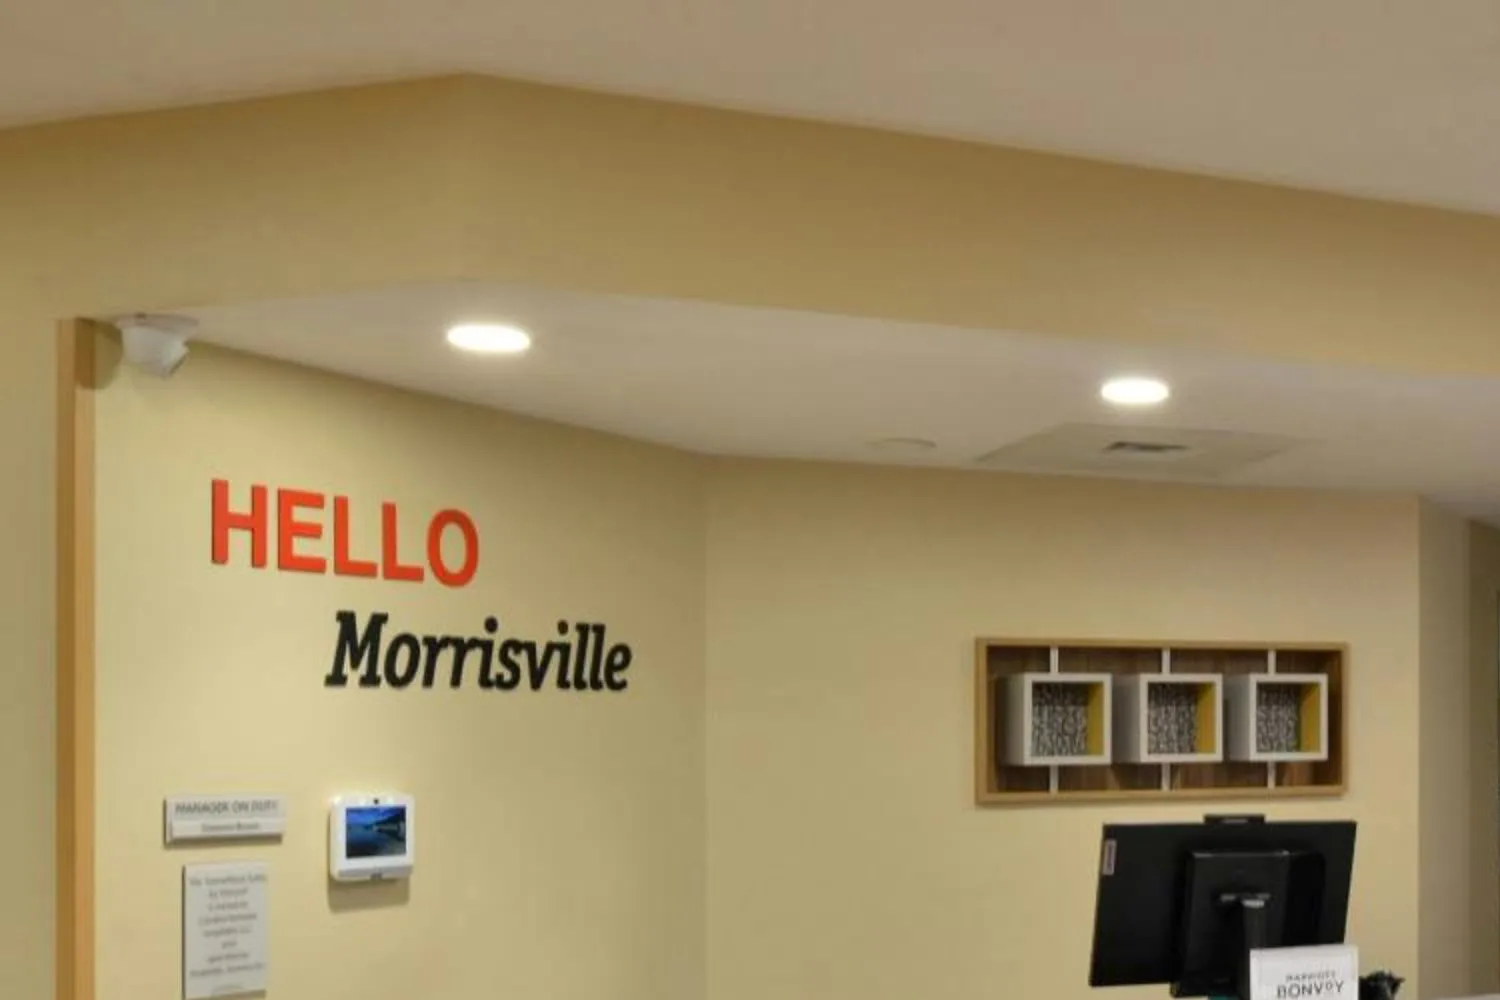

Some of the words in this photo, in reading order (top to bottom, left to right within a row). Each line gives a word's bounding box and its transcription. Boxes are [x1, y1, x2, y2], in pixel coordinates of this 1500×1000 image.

[211, 479, 479, 587] HELLO
[324, 610, 632, 692] Morrisville
[1277, 980, 1345, 1000] BONVOY
